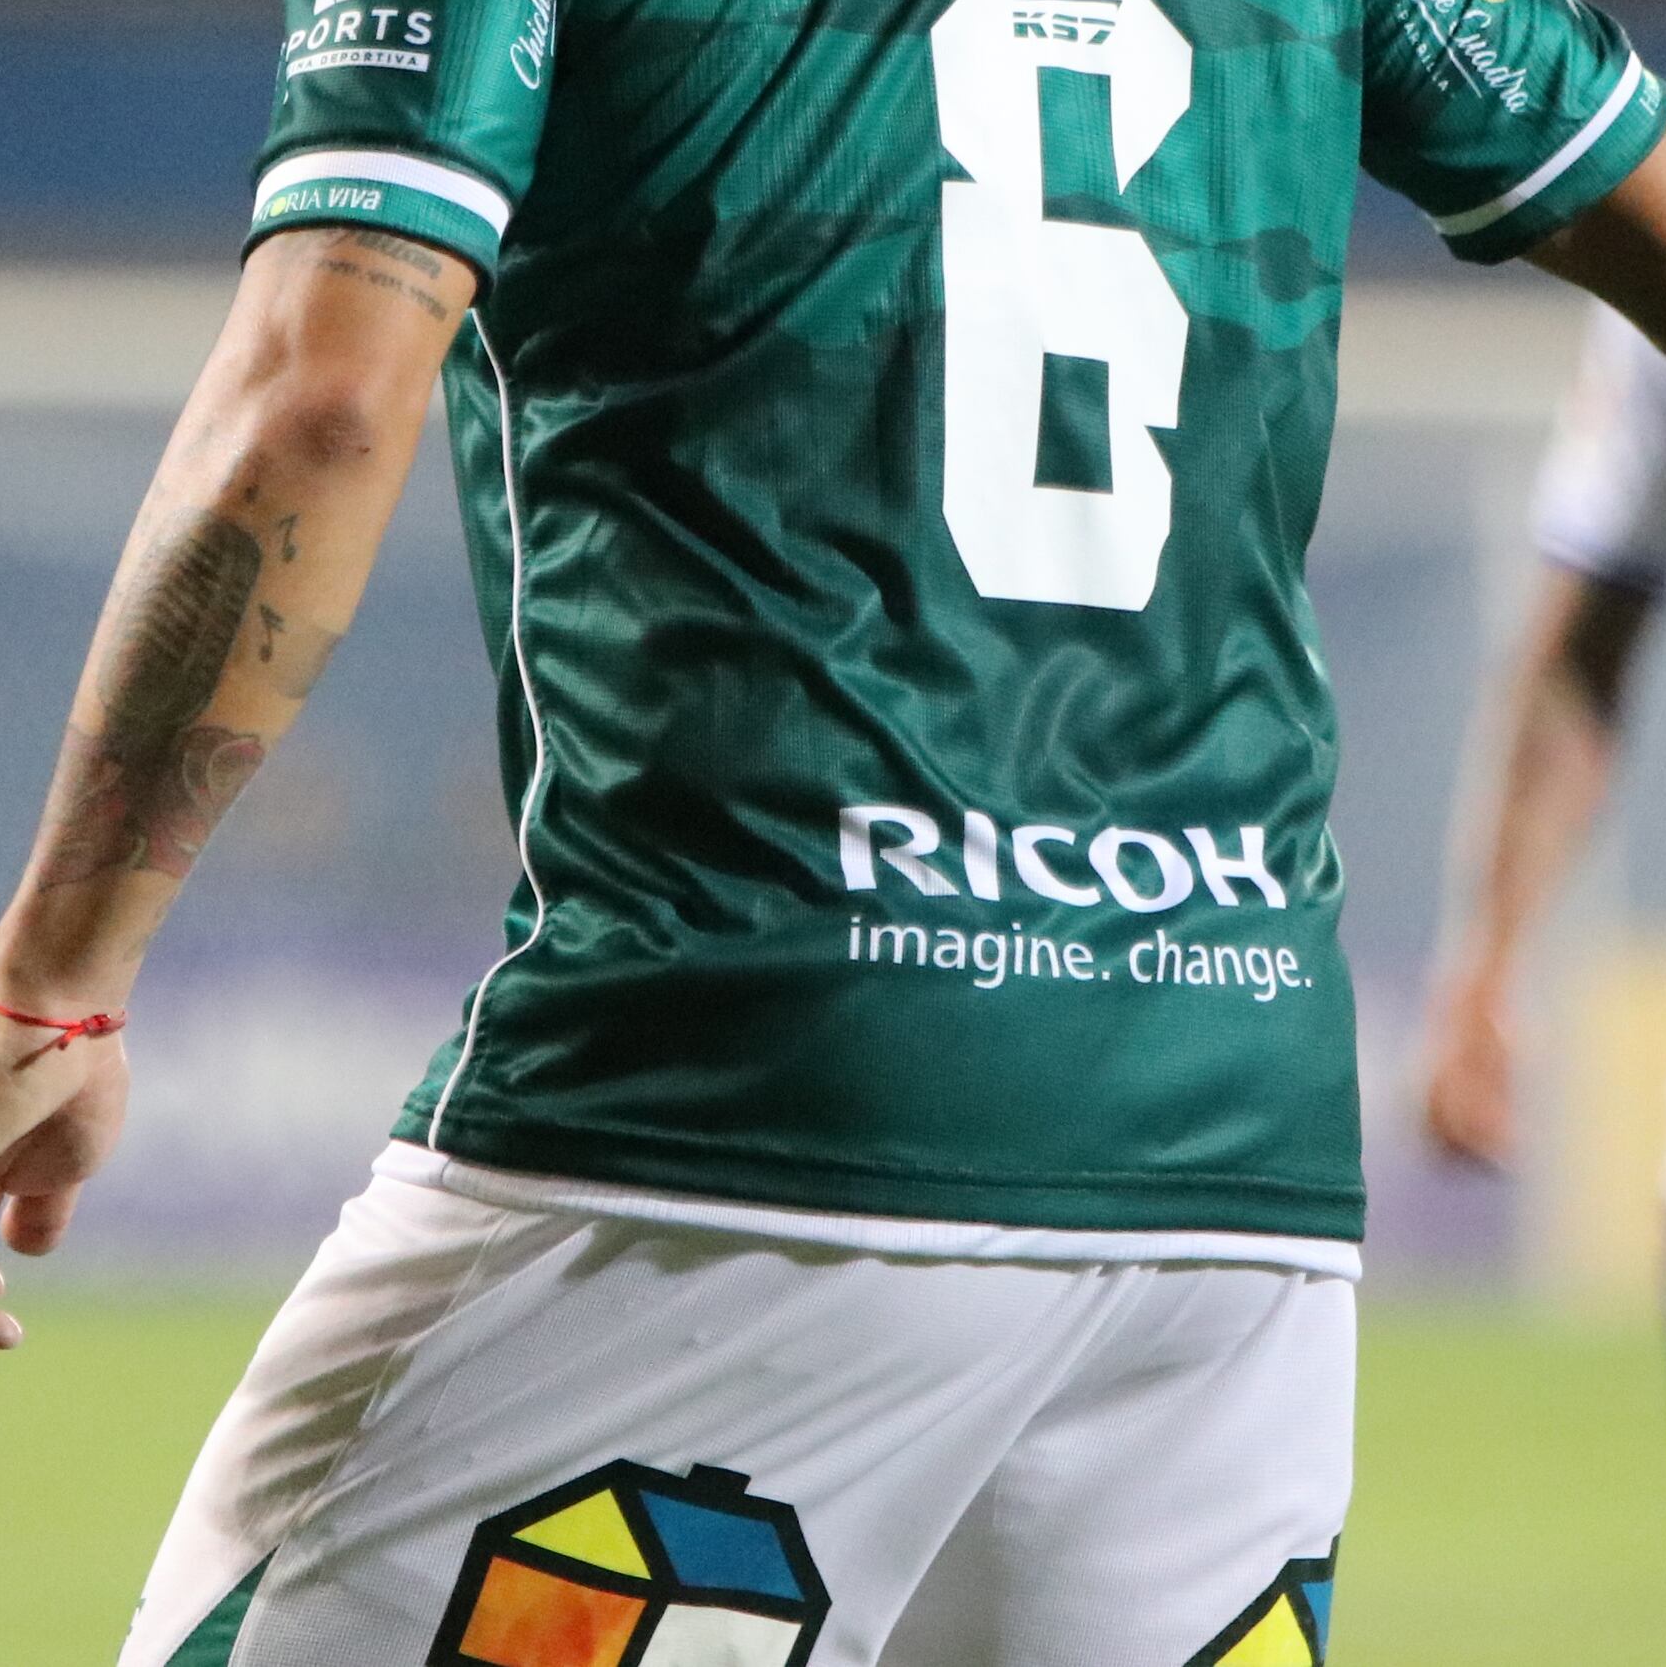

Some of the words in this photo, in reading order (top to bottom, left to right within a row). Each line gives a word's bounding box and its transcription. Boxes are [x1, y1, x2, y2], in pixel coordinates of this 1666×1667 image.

[280, 8, 433, 63] PORTS
[319, 51, 418, 68] DEPORTIVA
[1012, 11, 1117, 46] KS7
[1448, 9, 1529, 115] Cuadra
[839, 806, 1287, 914] RICOH
[849, 916, 1111, 990] imagine.
[1128, 929, 1312, 1002] change.
